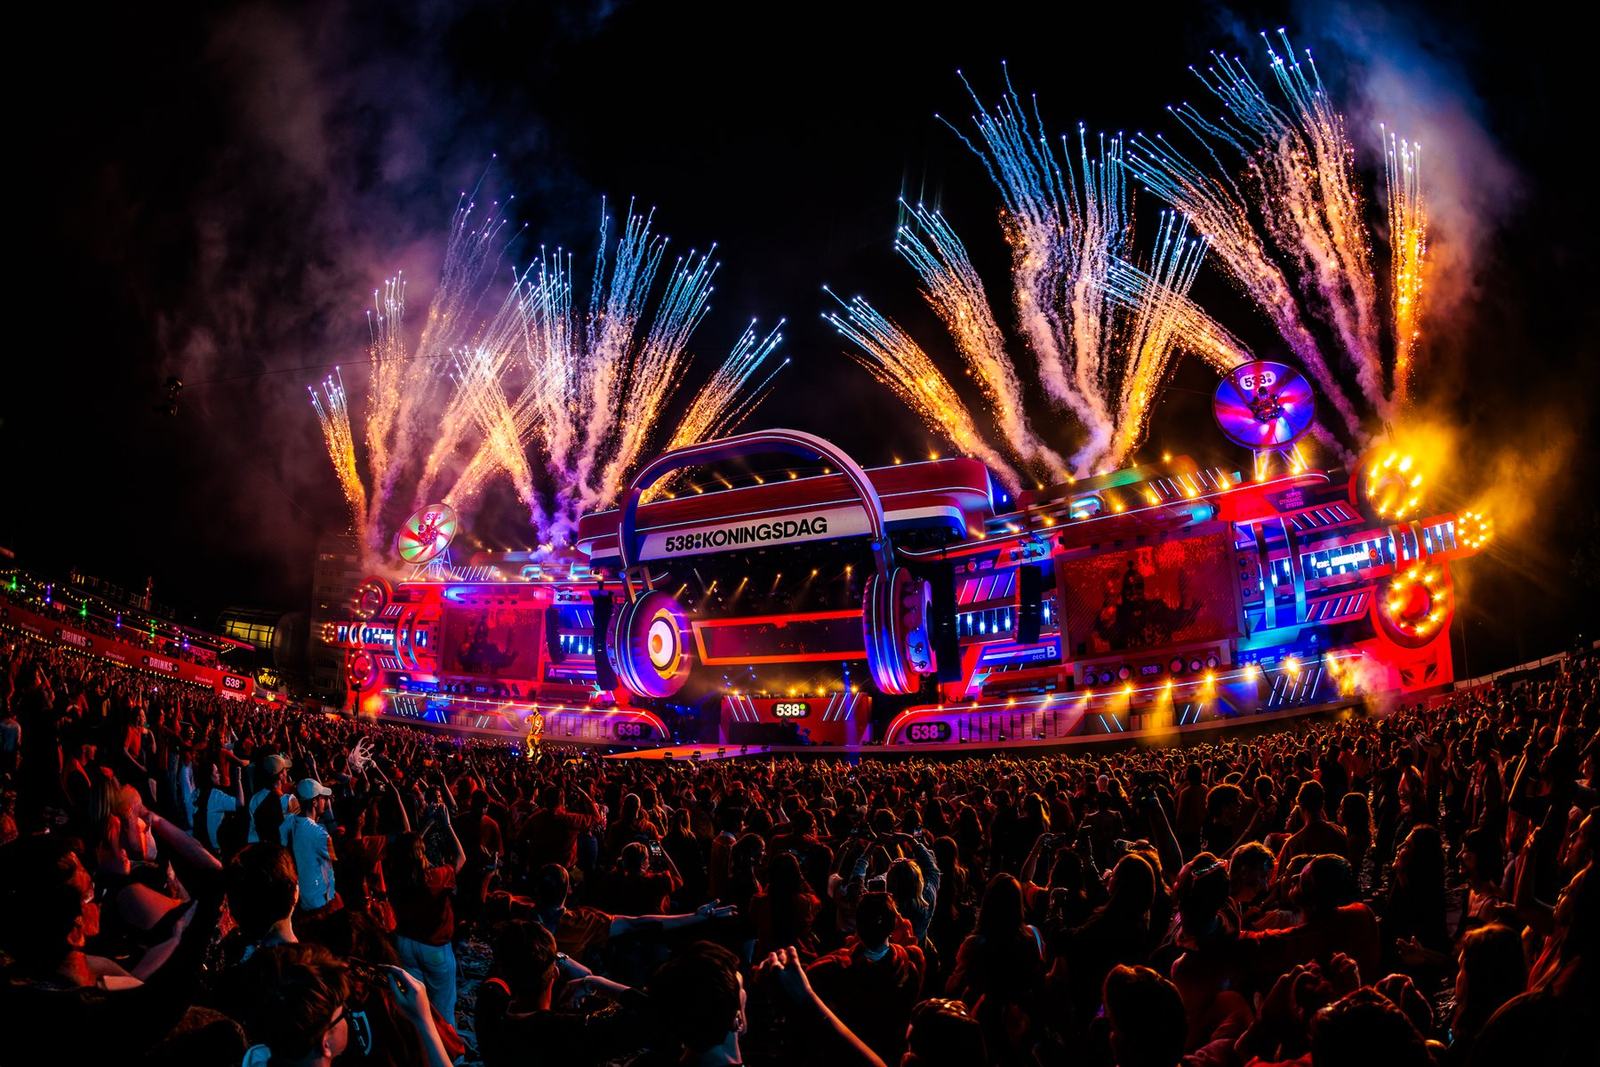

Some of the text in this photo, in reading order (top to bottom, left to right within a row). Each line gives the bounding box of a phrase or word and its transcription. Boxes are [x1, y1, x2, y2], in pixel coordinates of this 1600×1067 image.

[61, 629, 87, 647] DRINKS
[1046, 645, 1057, 658] B
[149, 656, 174, 672] DRINKS
[225, 676, 241, 689] 538
[776, 703, 800, 716] 538
[617, 723, 641, 737] 538
[911, 724, 939, 740] 538
